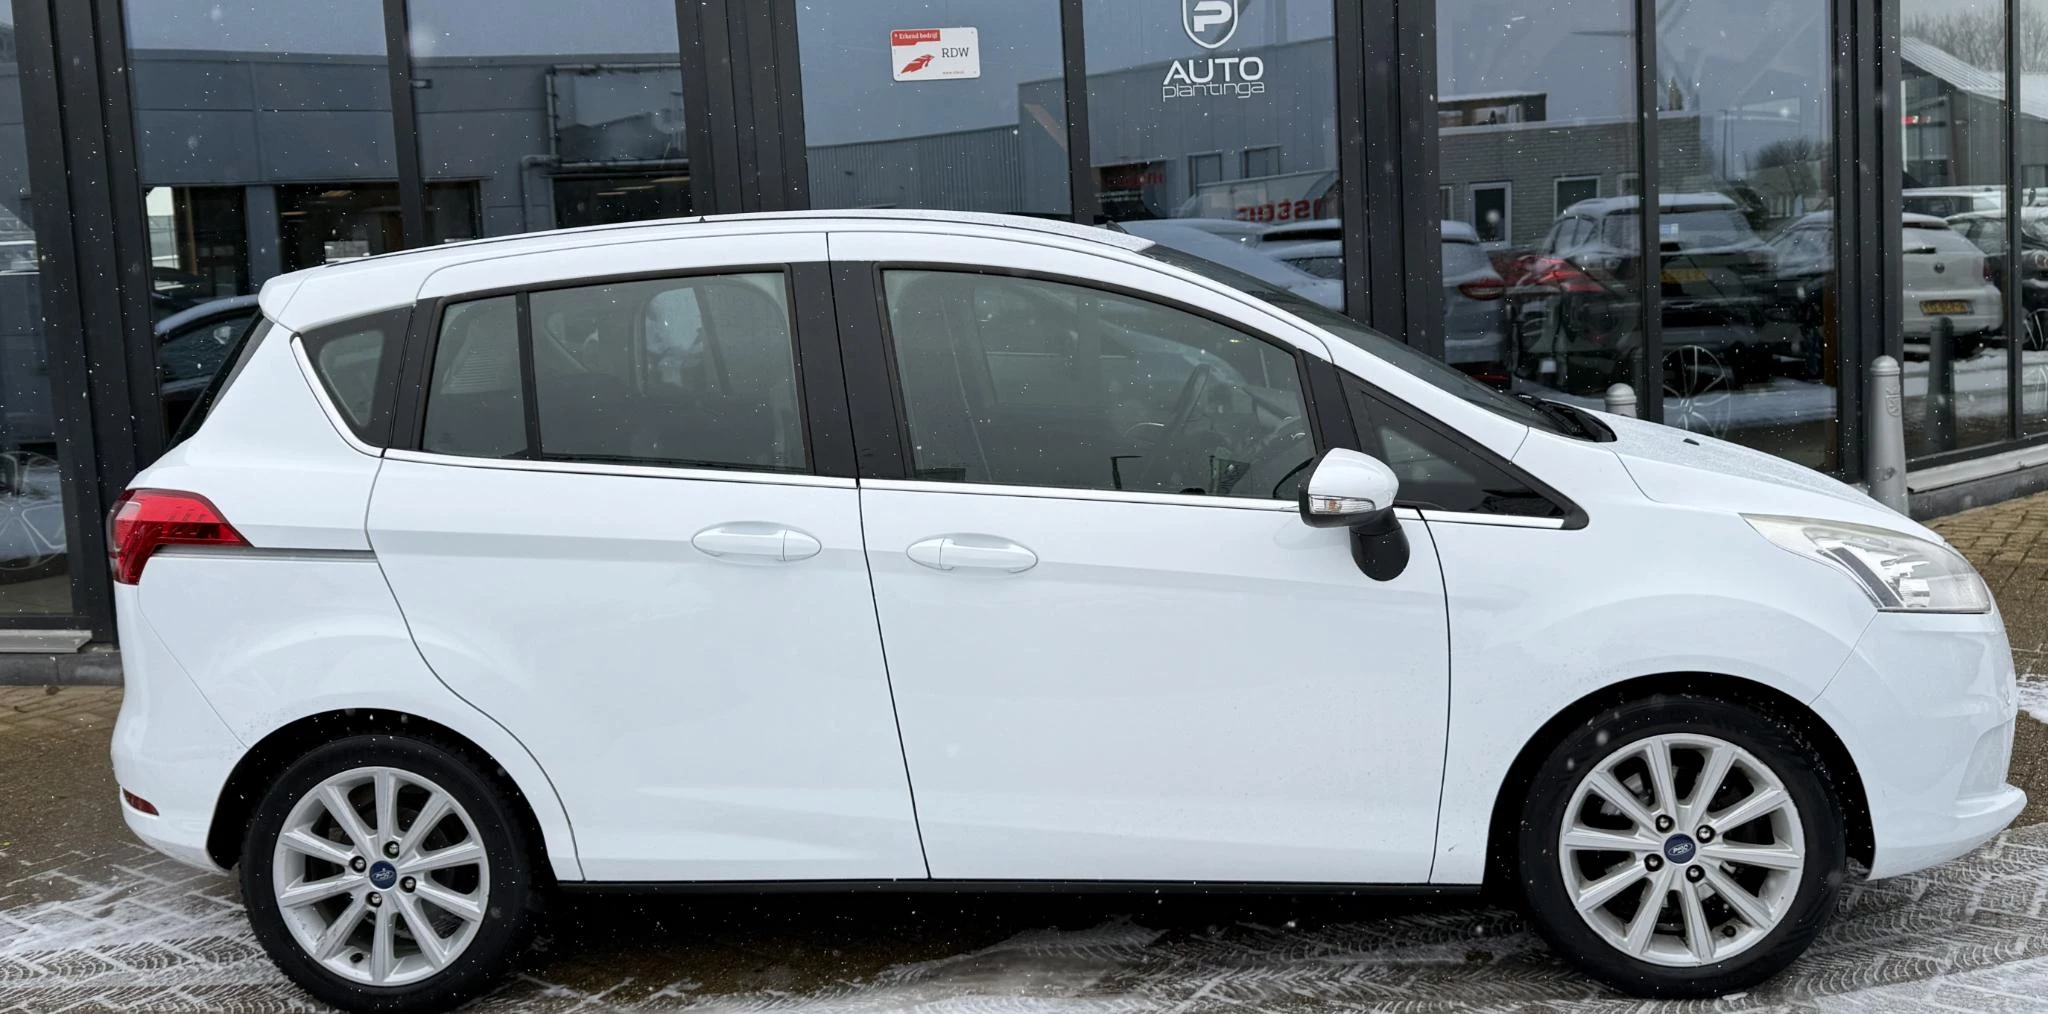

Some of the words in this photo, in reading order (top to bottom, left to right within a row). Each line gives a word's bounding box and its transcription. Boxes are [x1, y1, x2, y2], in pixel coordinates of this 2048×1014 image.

[1193, 0, 1233, 32] P
[941, 47, 969, 58] RDW
[1163, 57, 1264, 85] AUTO
[1162, 82, 1265, 102] plantinga
